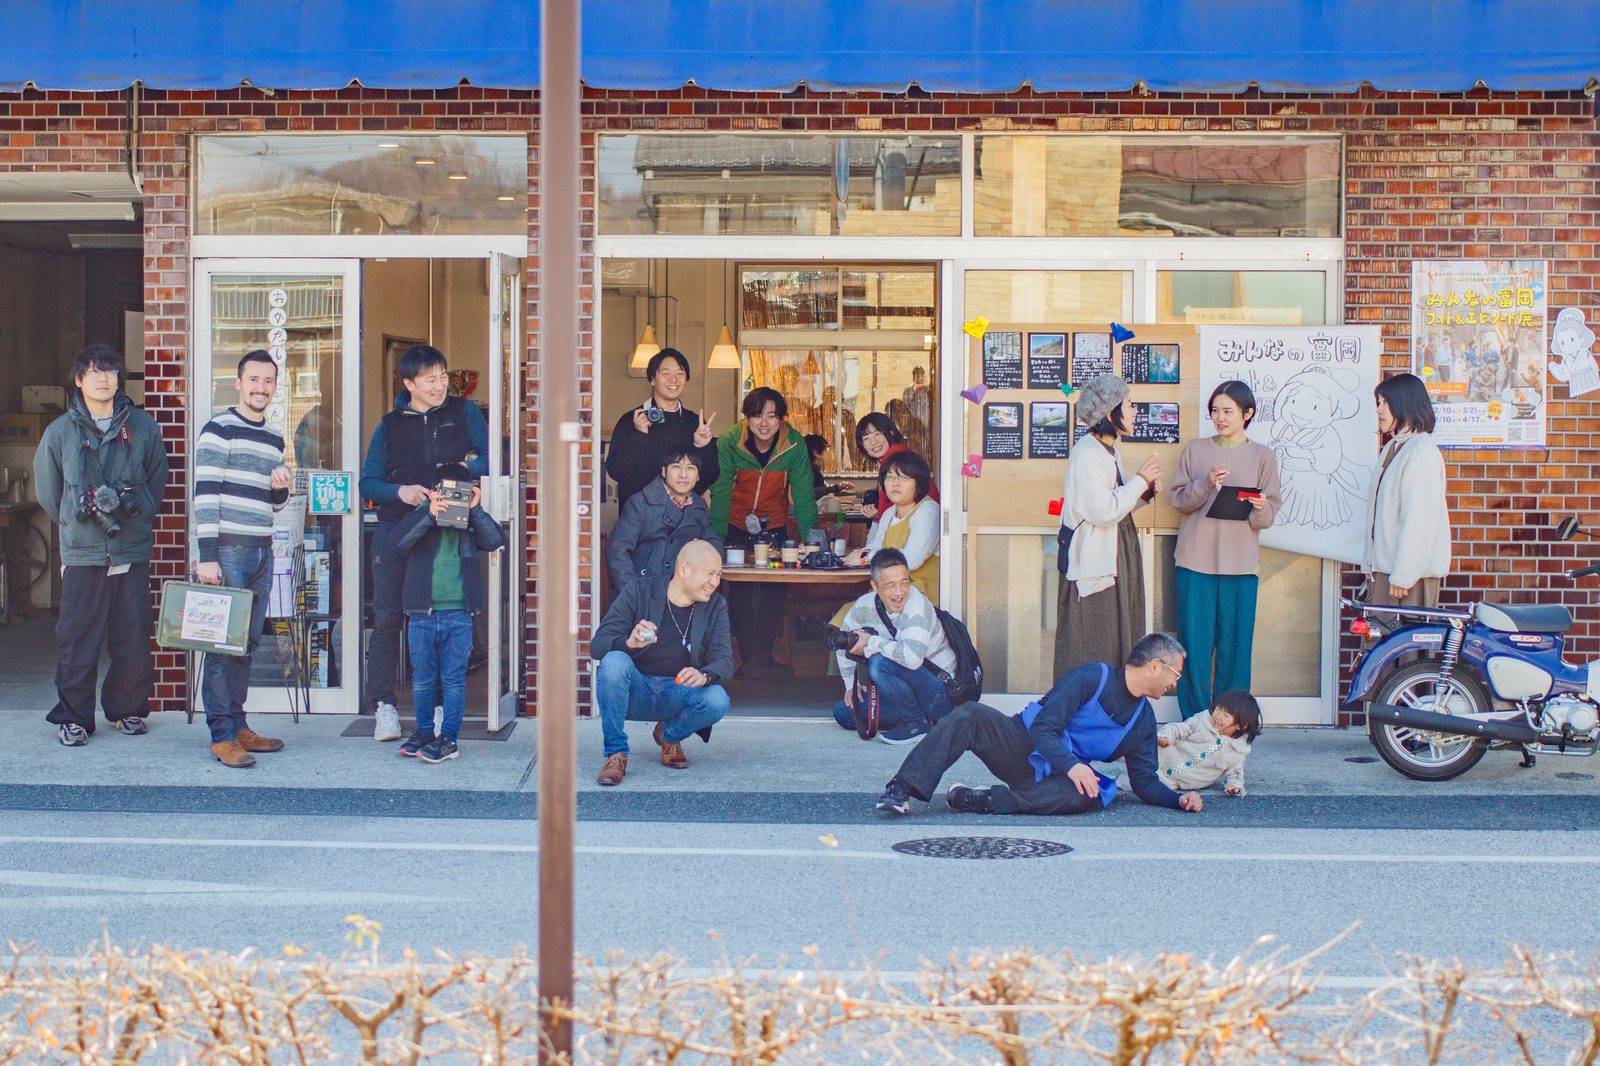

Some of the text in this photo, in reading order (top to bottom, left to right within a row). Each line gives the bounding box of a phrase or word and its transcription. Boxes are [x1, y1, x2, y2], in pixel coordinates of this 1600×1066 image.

[1426, 285, 1535, 308] みんなの富岡
[1426, 310, 1533, 327] フォト&エピソード展
[1217, 332, 1362, 363] みんなの富岡
[315, 477, 345, 487] こども
